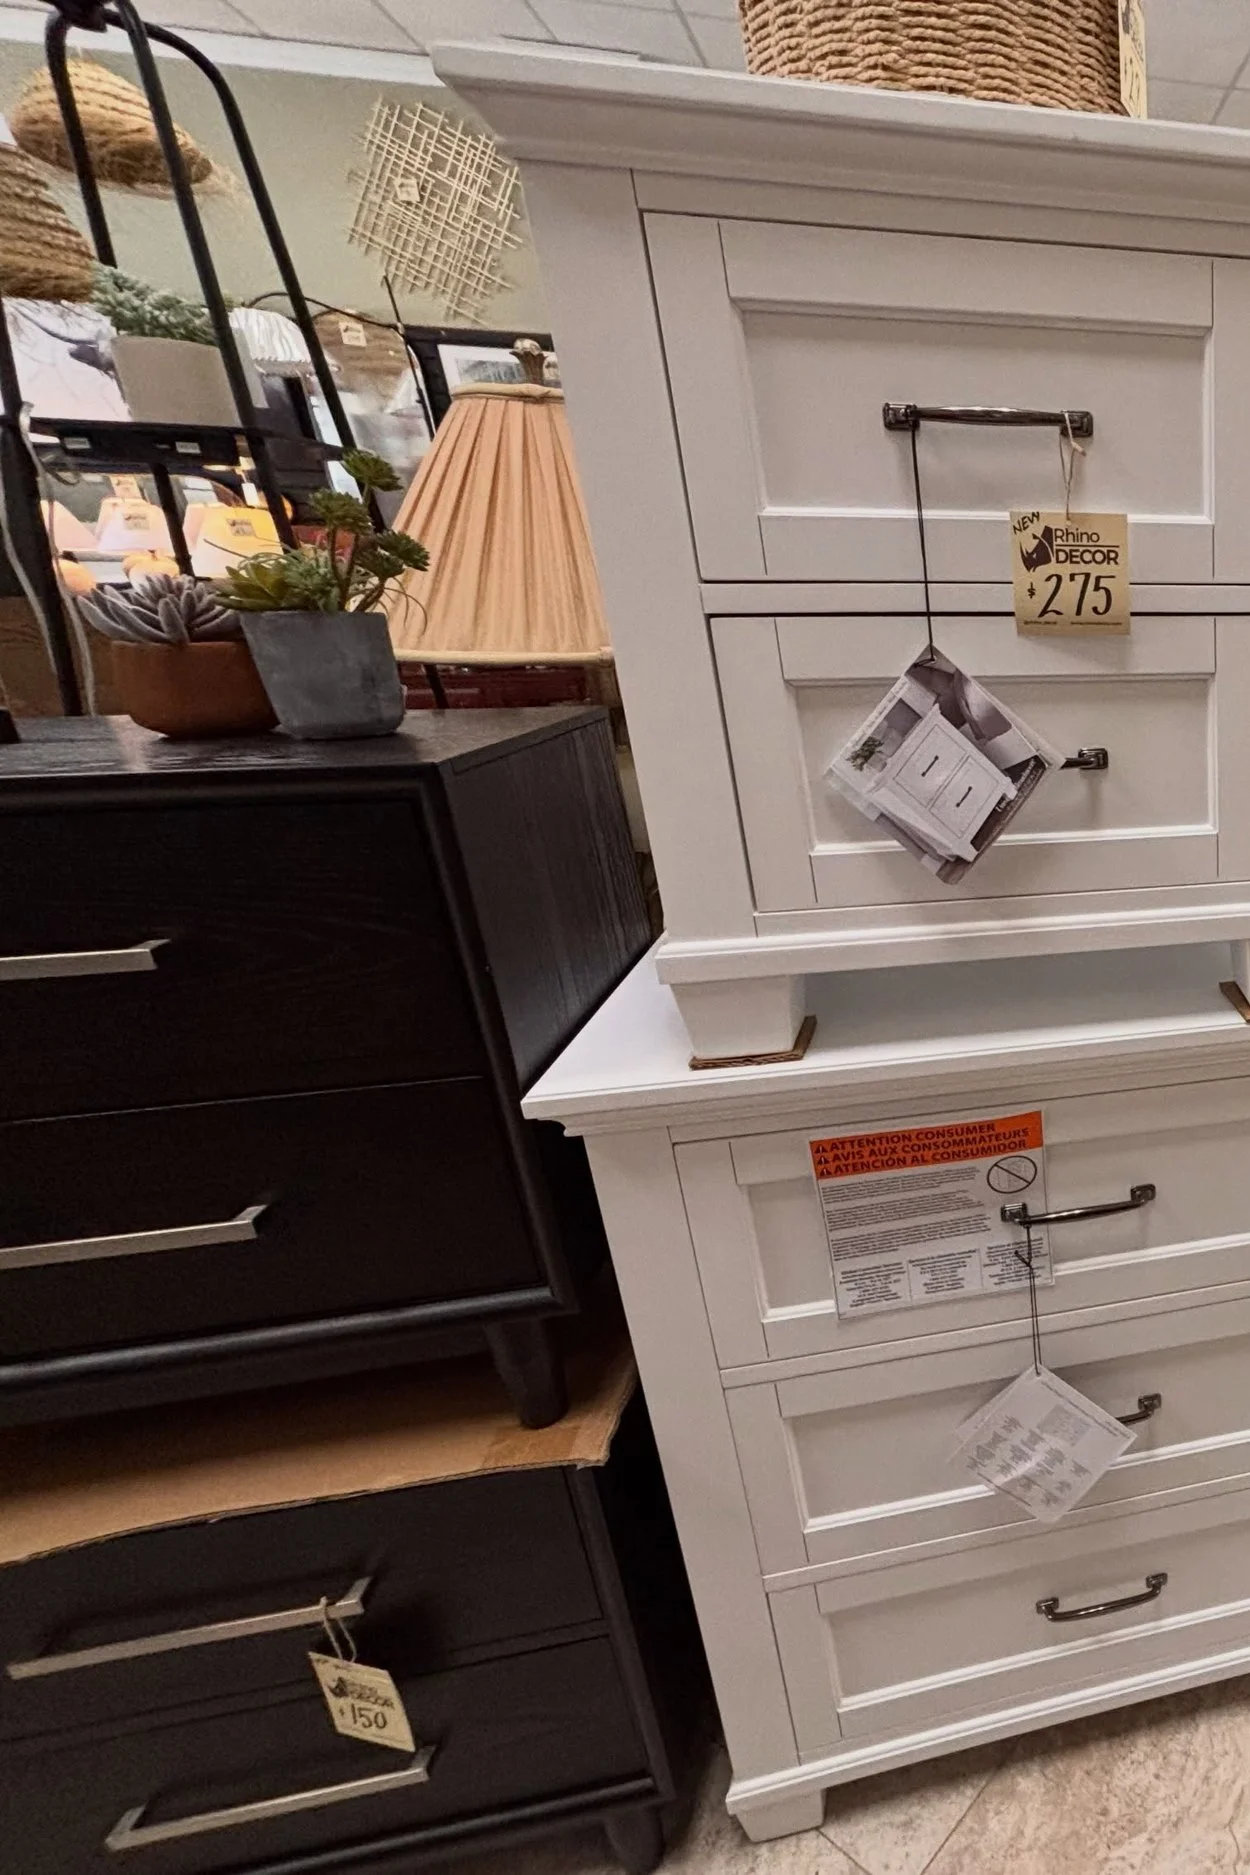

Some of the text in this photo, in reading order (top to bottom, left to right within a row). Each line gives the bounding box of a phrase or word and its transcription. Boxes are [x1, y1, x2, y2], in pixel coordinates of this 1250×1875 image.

[1012, 511, 1040, 535] NEW
[1053, 527, 1100, 543] Rhino
[1055, 549, 1120, 566] DECOR
[1027, 572, 1116, 618] $275
[829, 1123, 995, 1153] ATTENTION CONSUMER
[832, 1127, 1029, 1163] AVIS AUX CONSOMMATEURS
[911, 1153, 926, 1165] AL
[931, 1139, 1026, 1161] CONSUMIDOR
